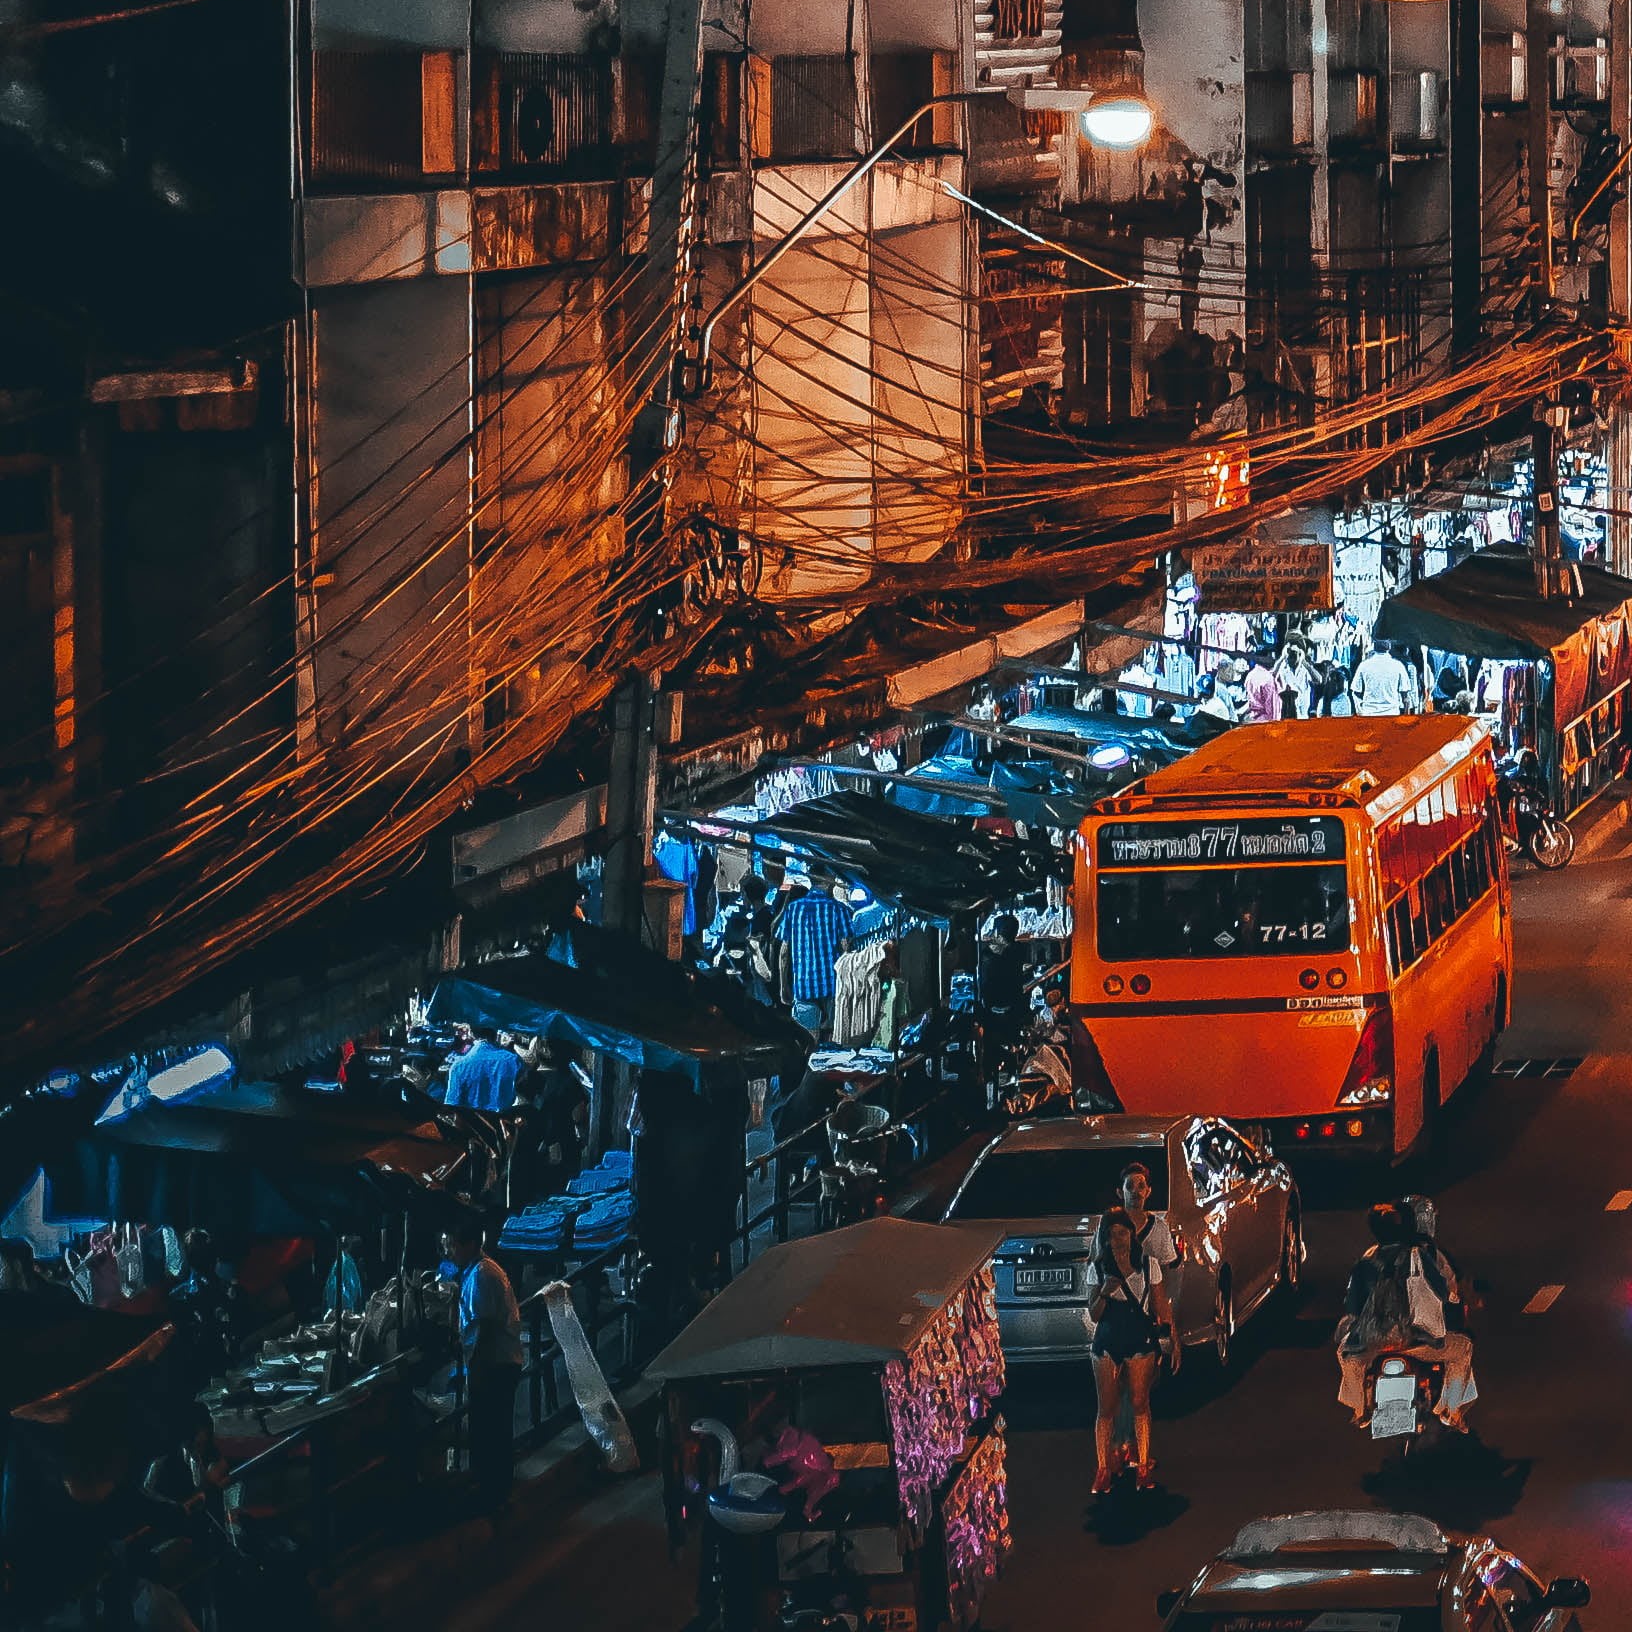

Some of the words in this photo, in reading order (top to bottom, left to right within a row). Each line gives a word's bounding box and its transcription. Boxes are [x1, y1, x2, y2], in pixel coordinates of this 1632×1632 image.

[1202, 824, 1239, 858] 77
[1311, 830, 1326, 855] 2
[1260, 923, 1327, 943] 77-12
